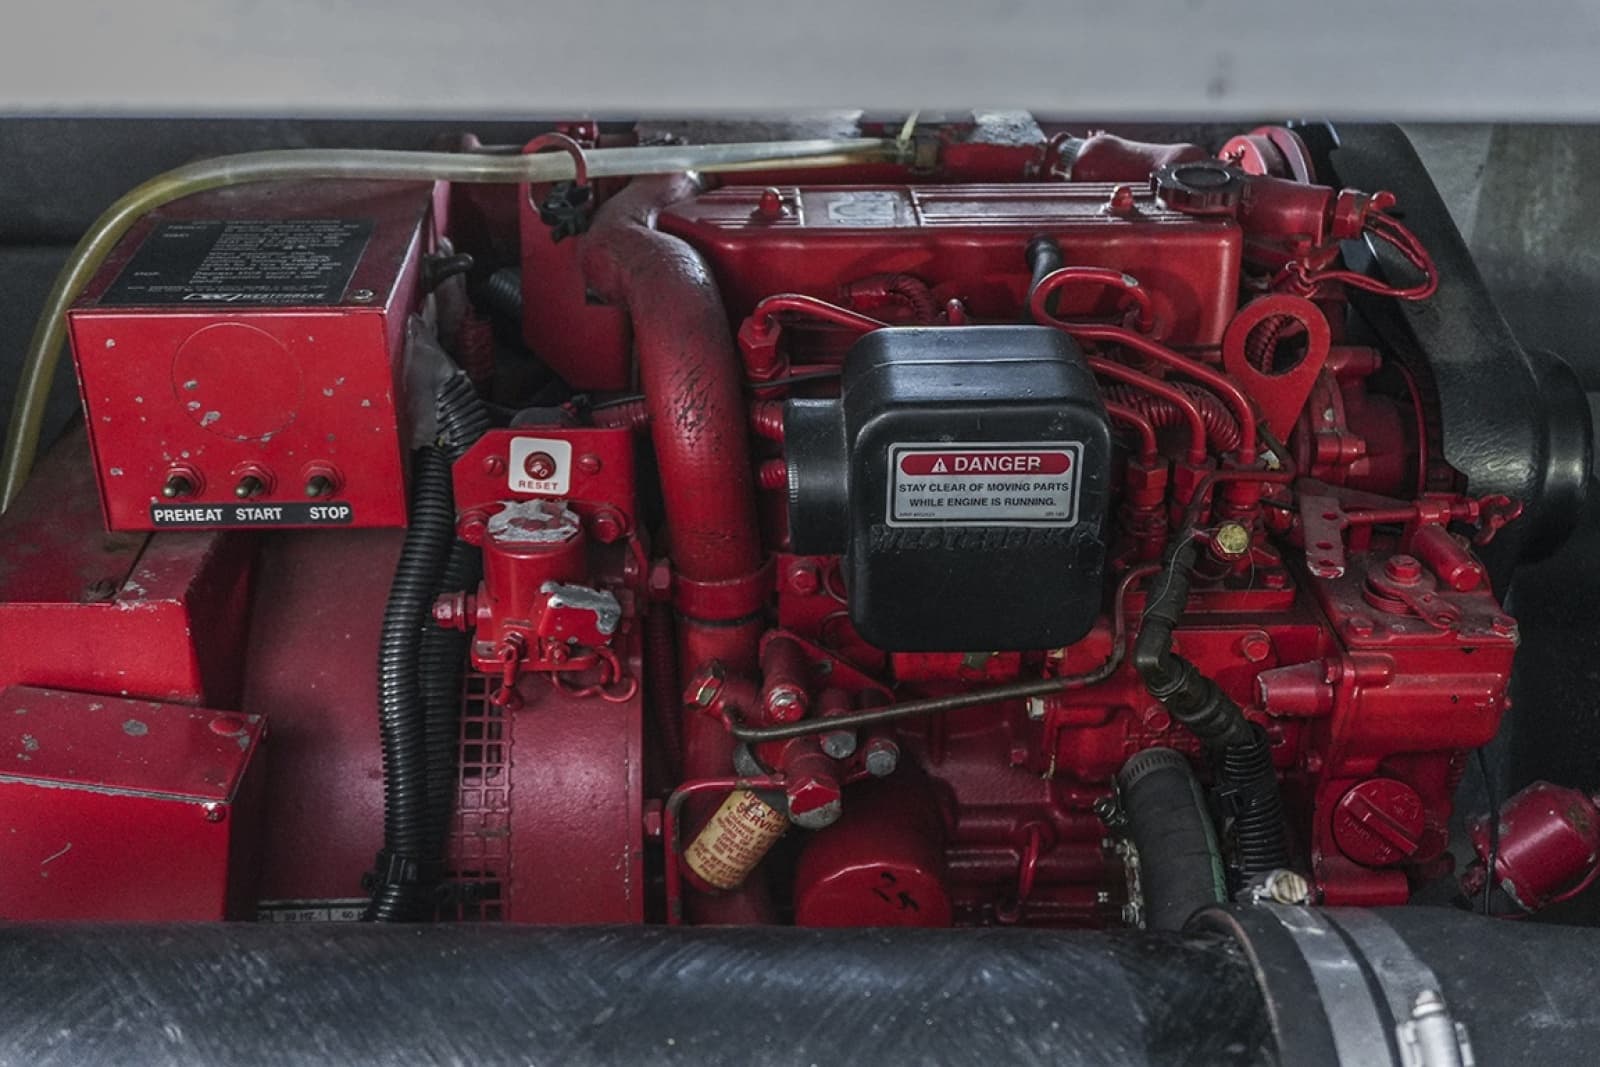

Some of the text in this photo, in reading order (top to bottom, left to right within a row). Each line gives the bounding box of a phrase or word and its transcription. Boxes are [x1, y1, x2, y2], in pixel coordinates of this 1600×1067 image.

[954, 456, 1041, 471] DANGER
[518, 480, 558, 490] RESET
[899, 482, 1069, 492] STAY CLEAR OF MOVING PARTS
[909, 496, 1057, 507] WHILE ENGINE IS RUNNING.
[153, 508, 223, 522] PREHEAT
[235, 507, 283, 521] START
[309, 506, 350, 519] STOP
